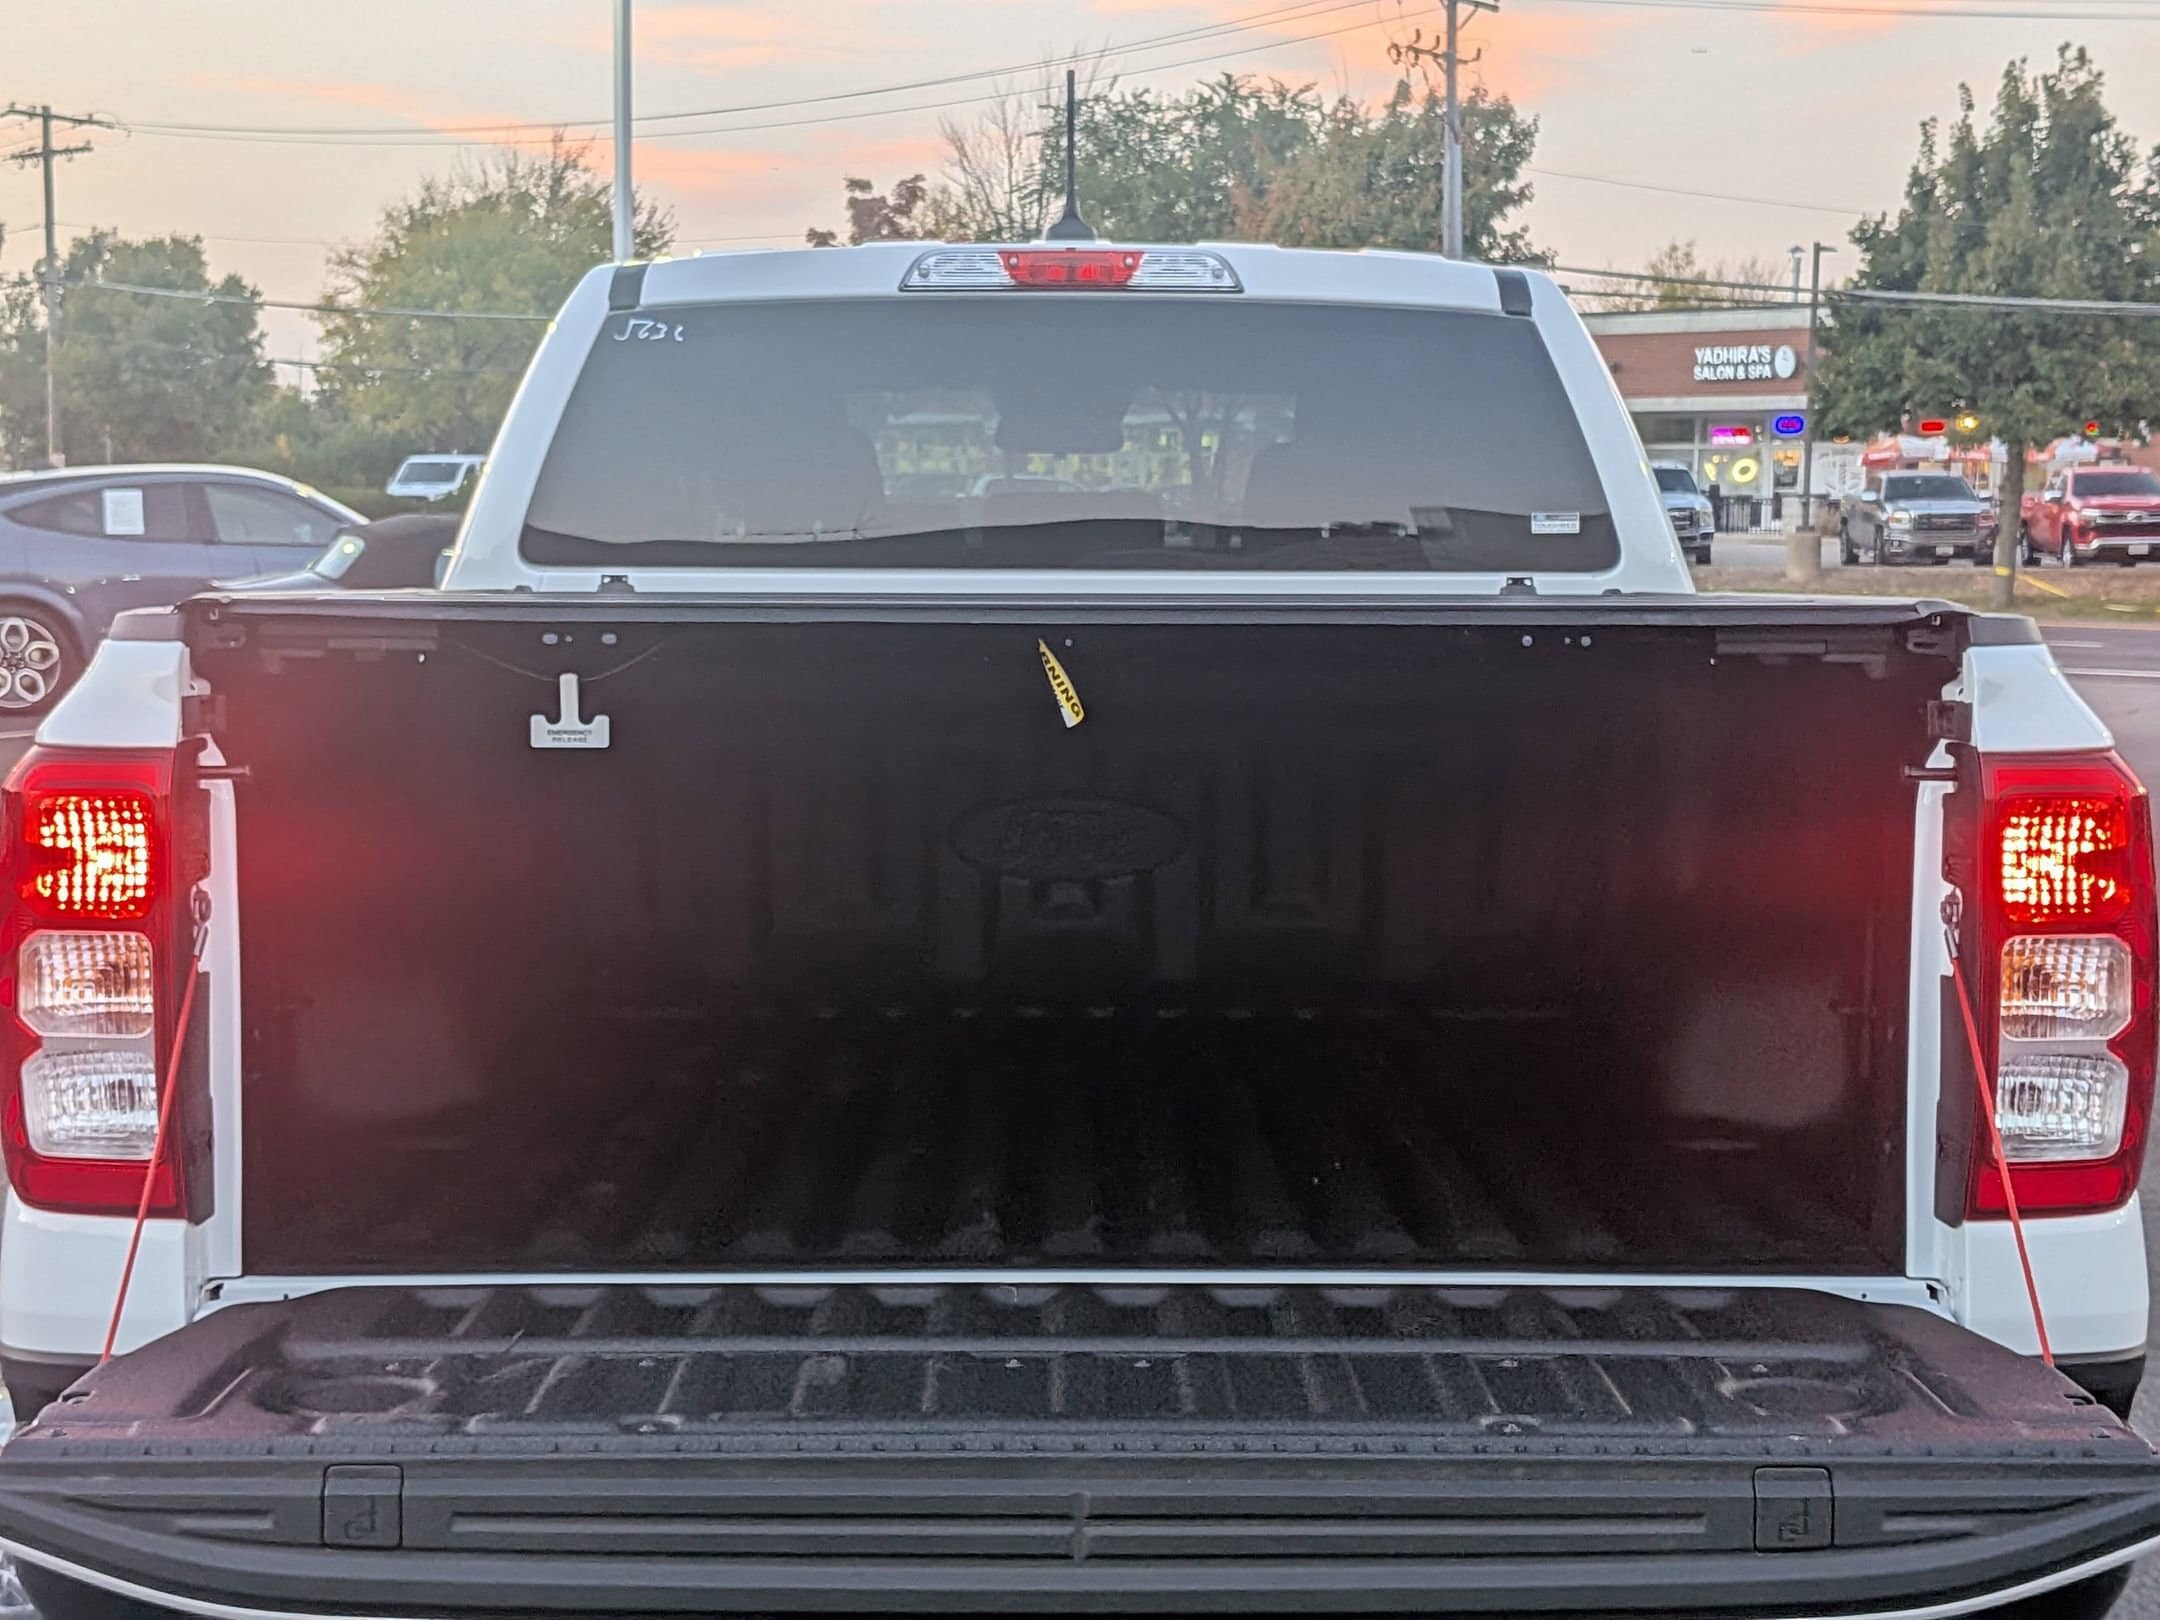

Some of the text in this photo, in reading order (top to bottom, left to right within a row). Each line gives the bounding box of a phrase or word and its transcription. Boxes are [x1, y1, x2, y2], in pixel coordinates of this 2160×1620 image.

[1694, 345, 1771, 365] YADHIRA'S
[1693, 364, 1772, 381] SALON & SPA
